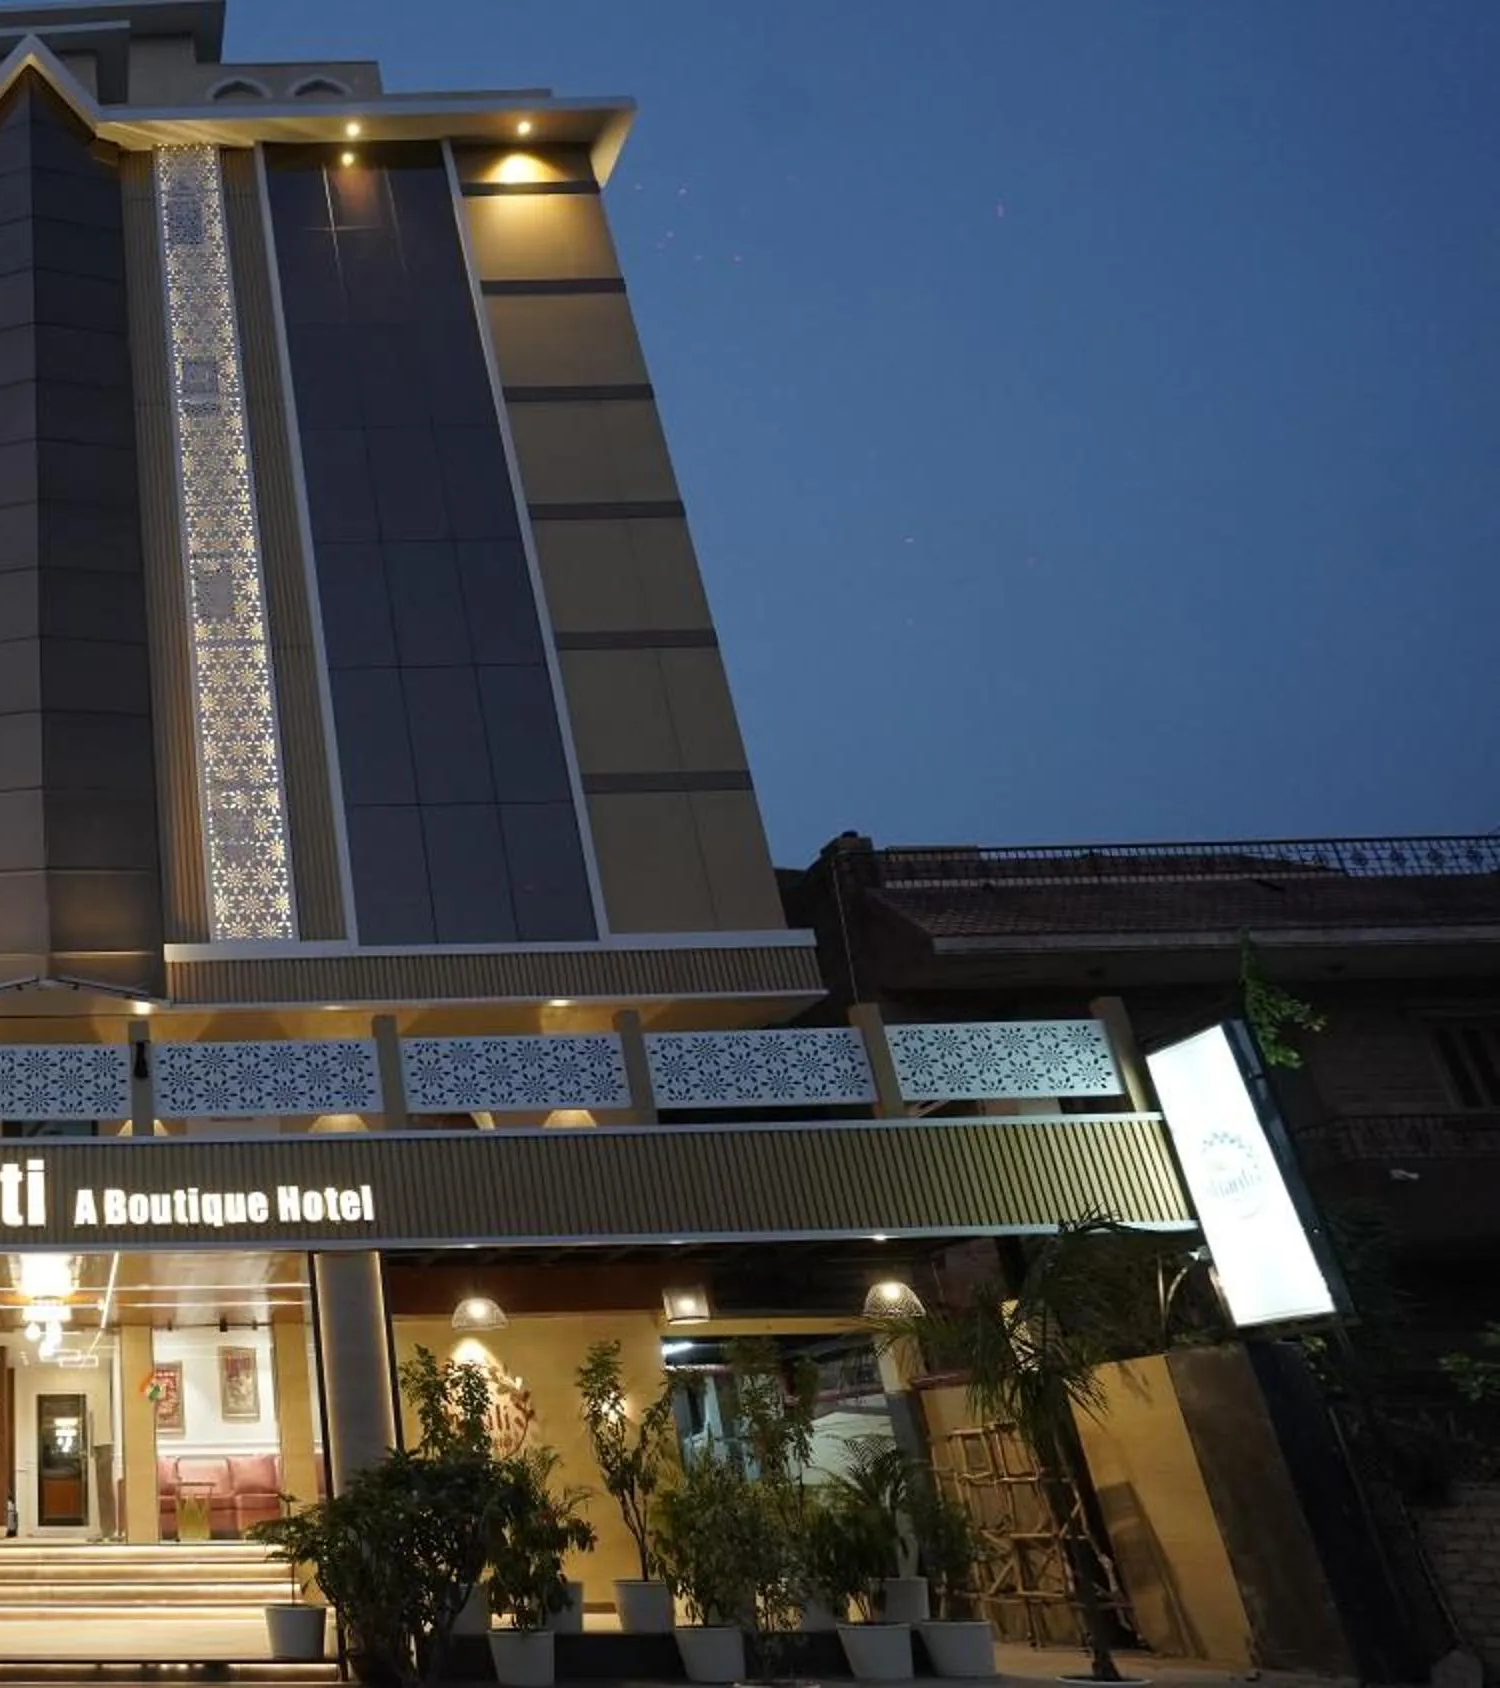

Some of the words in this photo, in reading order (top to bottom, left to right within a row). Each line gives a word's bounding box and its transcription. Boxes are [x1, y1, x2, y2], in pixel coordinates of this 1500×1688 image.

[74, 1188, 99, 1225] A
[103, 1187, 269, 1227] Boutique
[277, 1184, 375, 1222] Hotel
